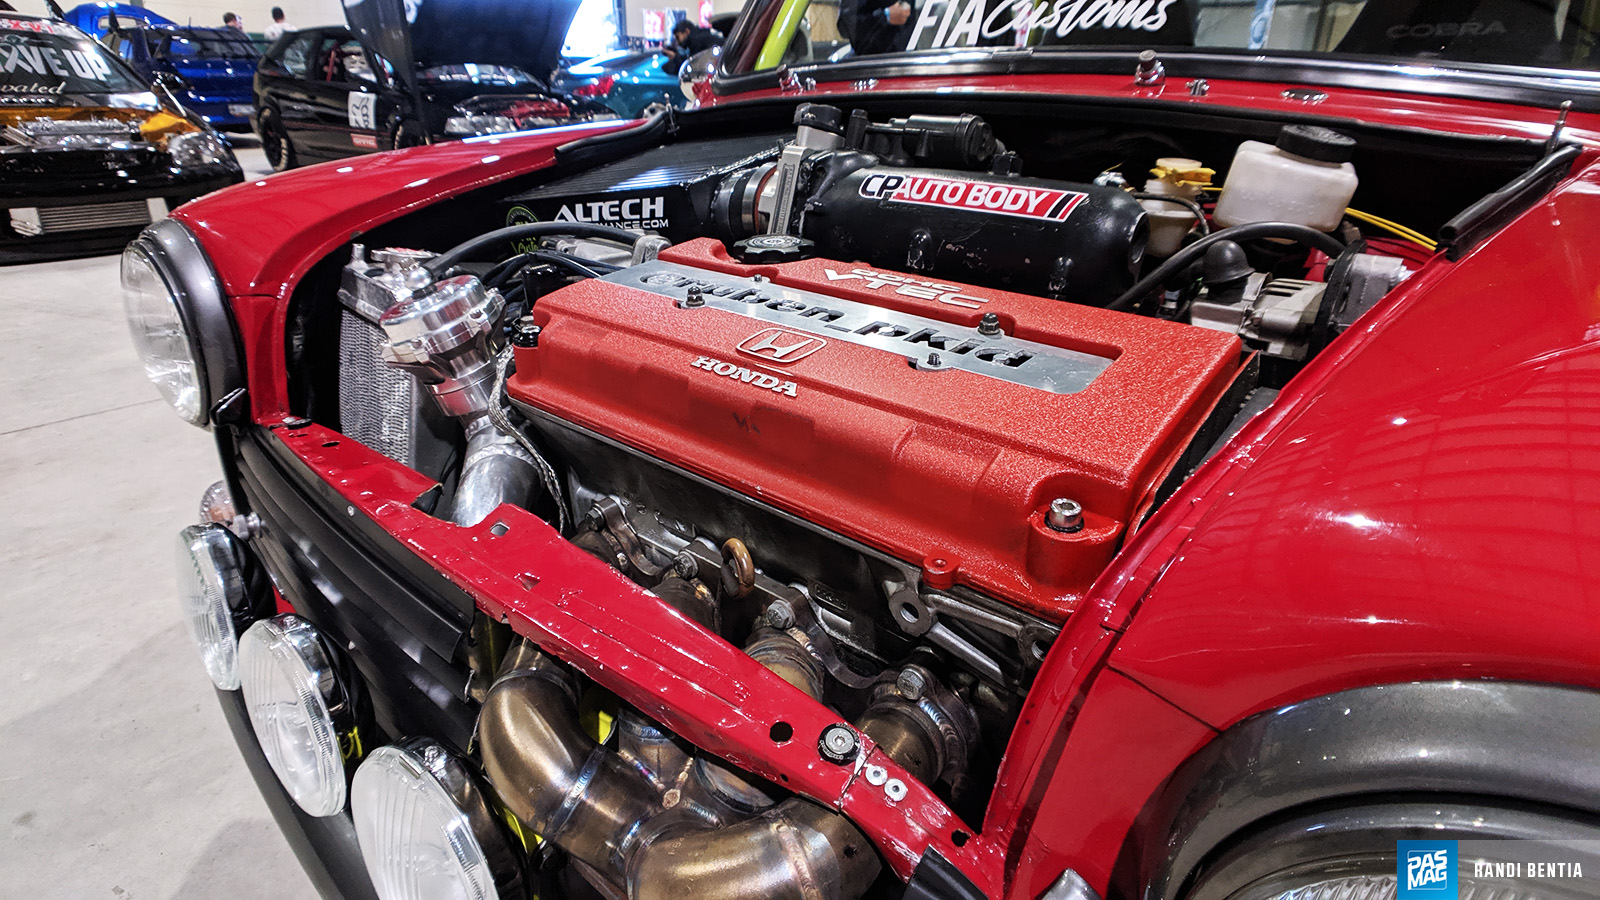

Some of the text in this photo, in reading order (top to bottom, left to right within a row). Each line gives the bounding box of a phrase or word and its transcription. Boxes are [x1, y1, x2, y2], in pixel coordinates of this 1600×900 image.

[981, 0, 1180, 38] Customs
[1386, 20, 1507, 38] COBRA
[61, 48, 113, 81] UP
[553, 196, 665, 223] ALTECH
[893, 177, 966, 204] AUTO
[965, 185, 1051, 213] BODY
[823, 268, 990, 310] VTEC
[851, 268, 963, 293] DOHC
[690, 355, 798, 398] HONDA
